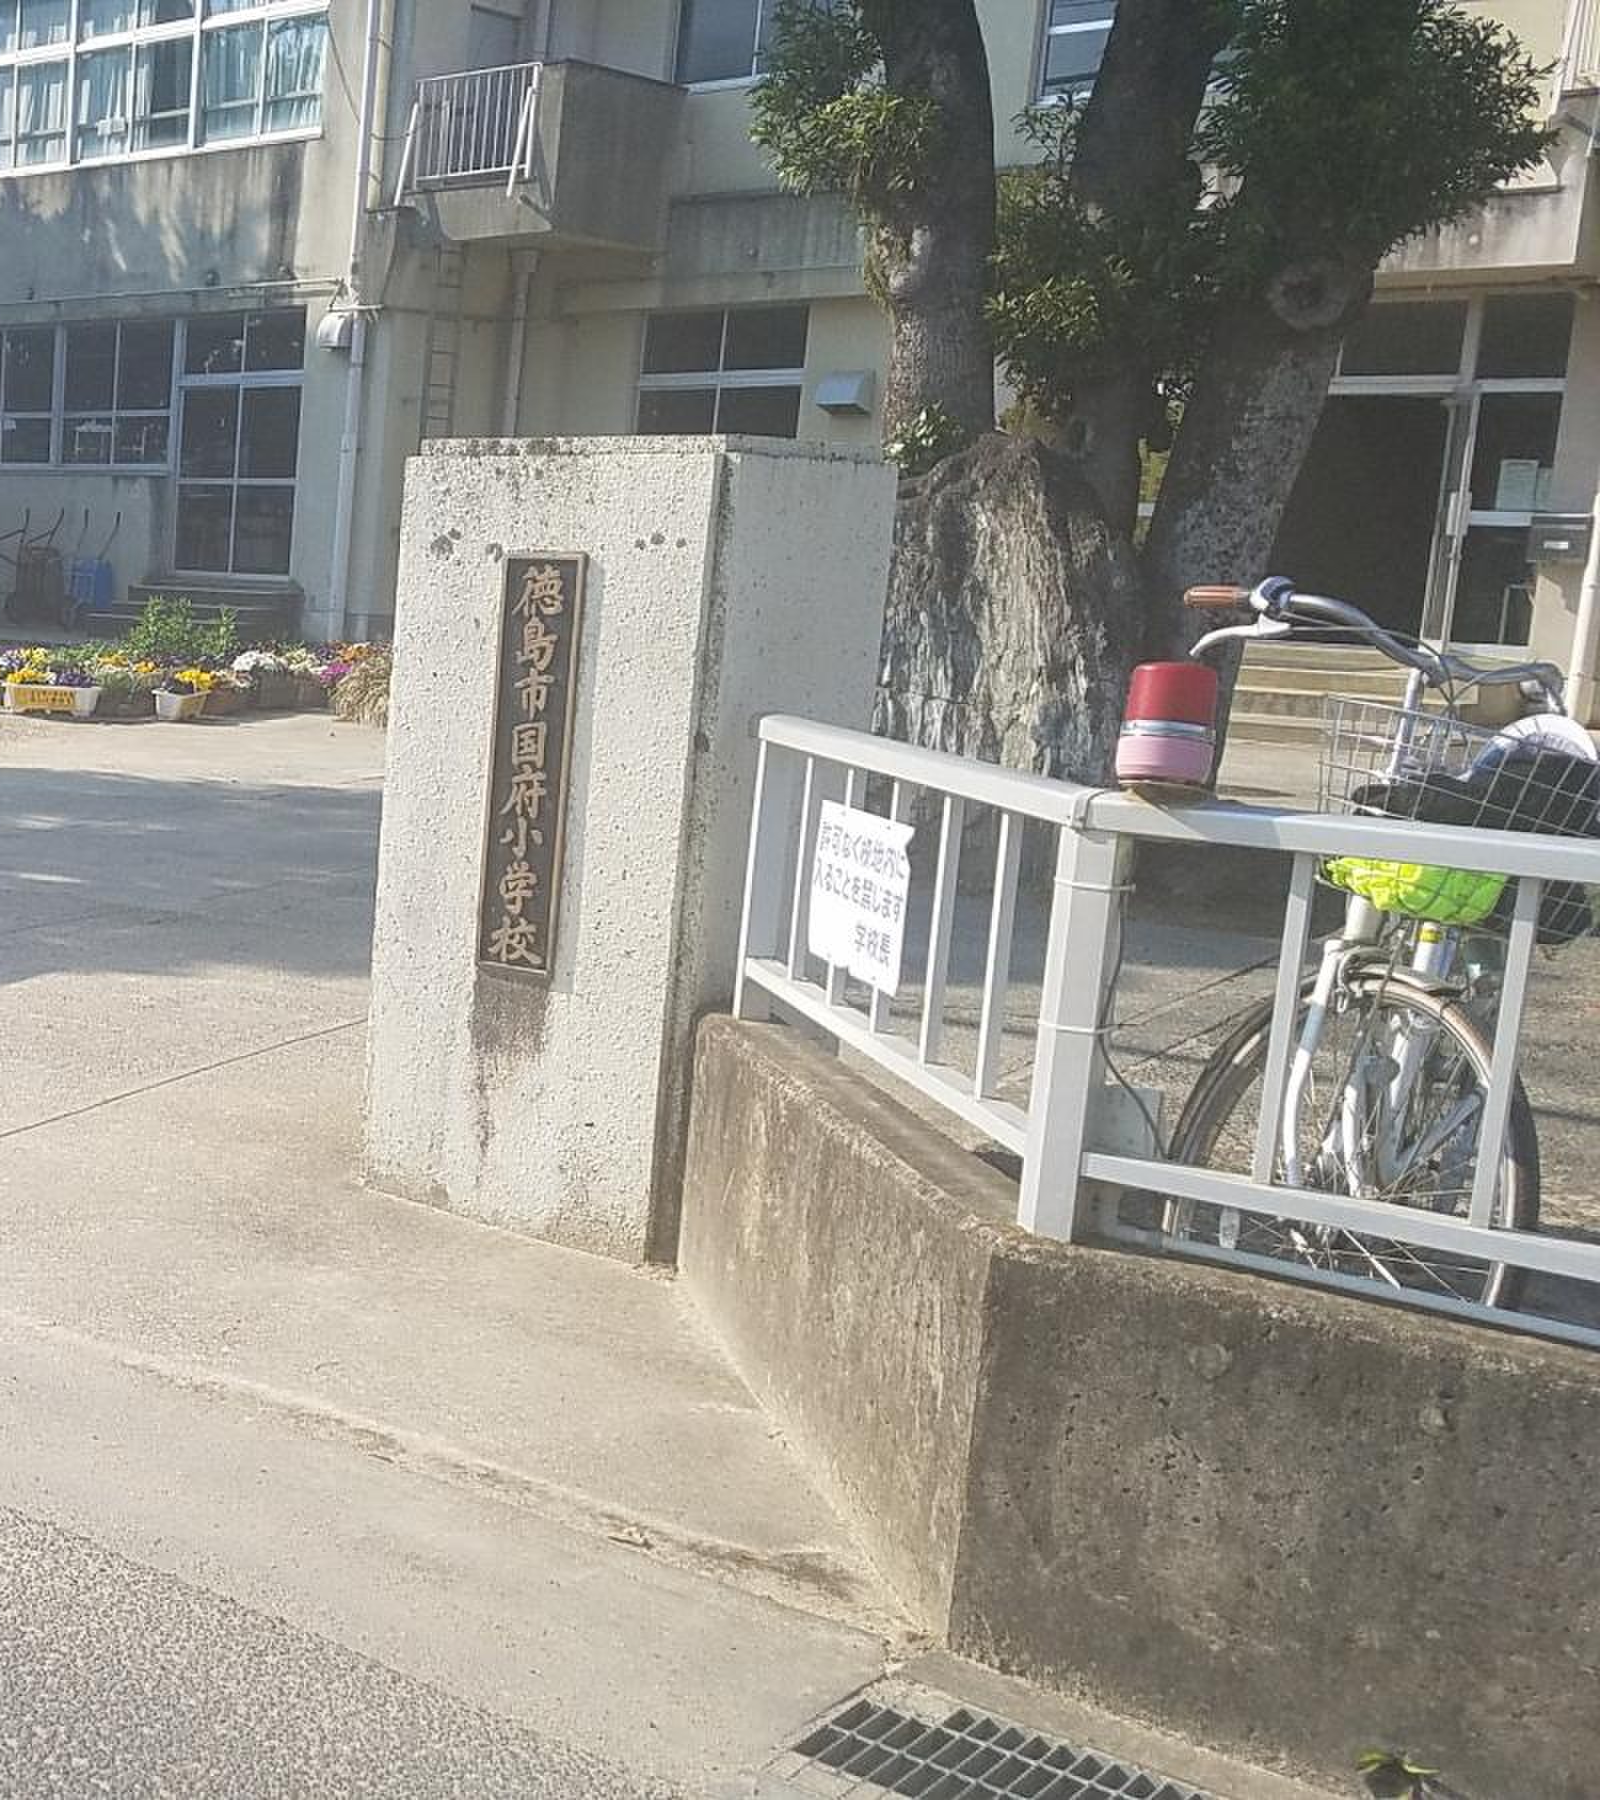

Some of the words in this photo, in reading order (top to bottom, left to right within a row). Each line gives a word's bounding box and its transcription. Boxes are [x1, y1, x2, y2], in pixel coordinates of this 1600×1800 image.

[488, 565, 563, 966] 徳島市国府小学校
